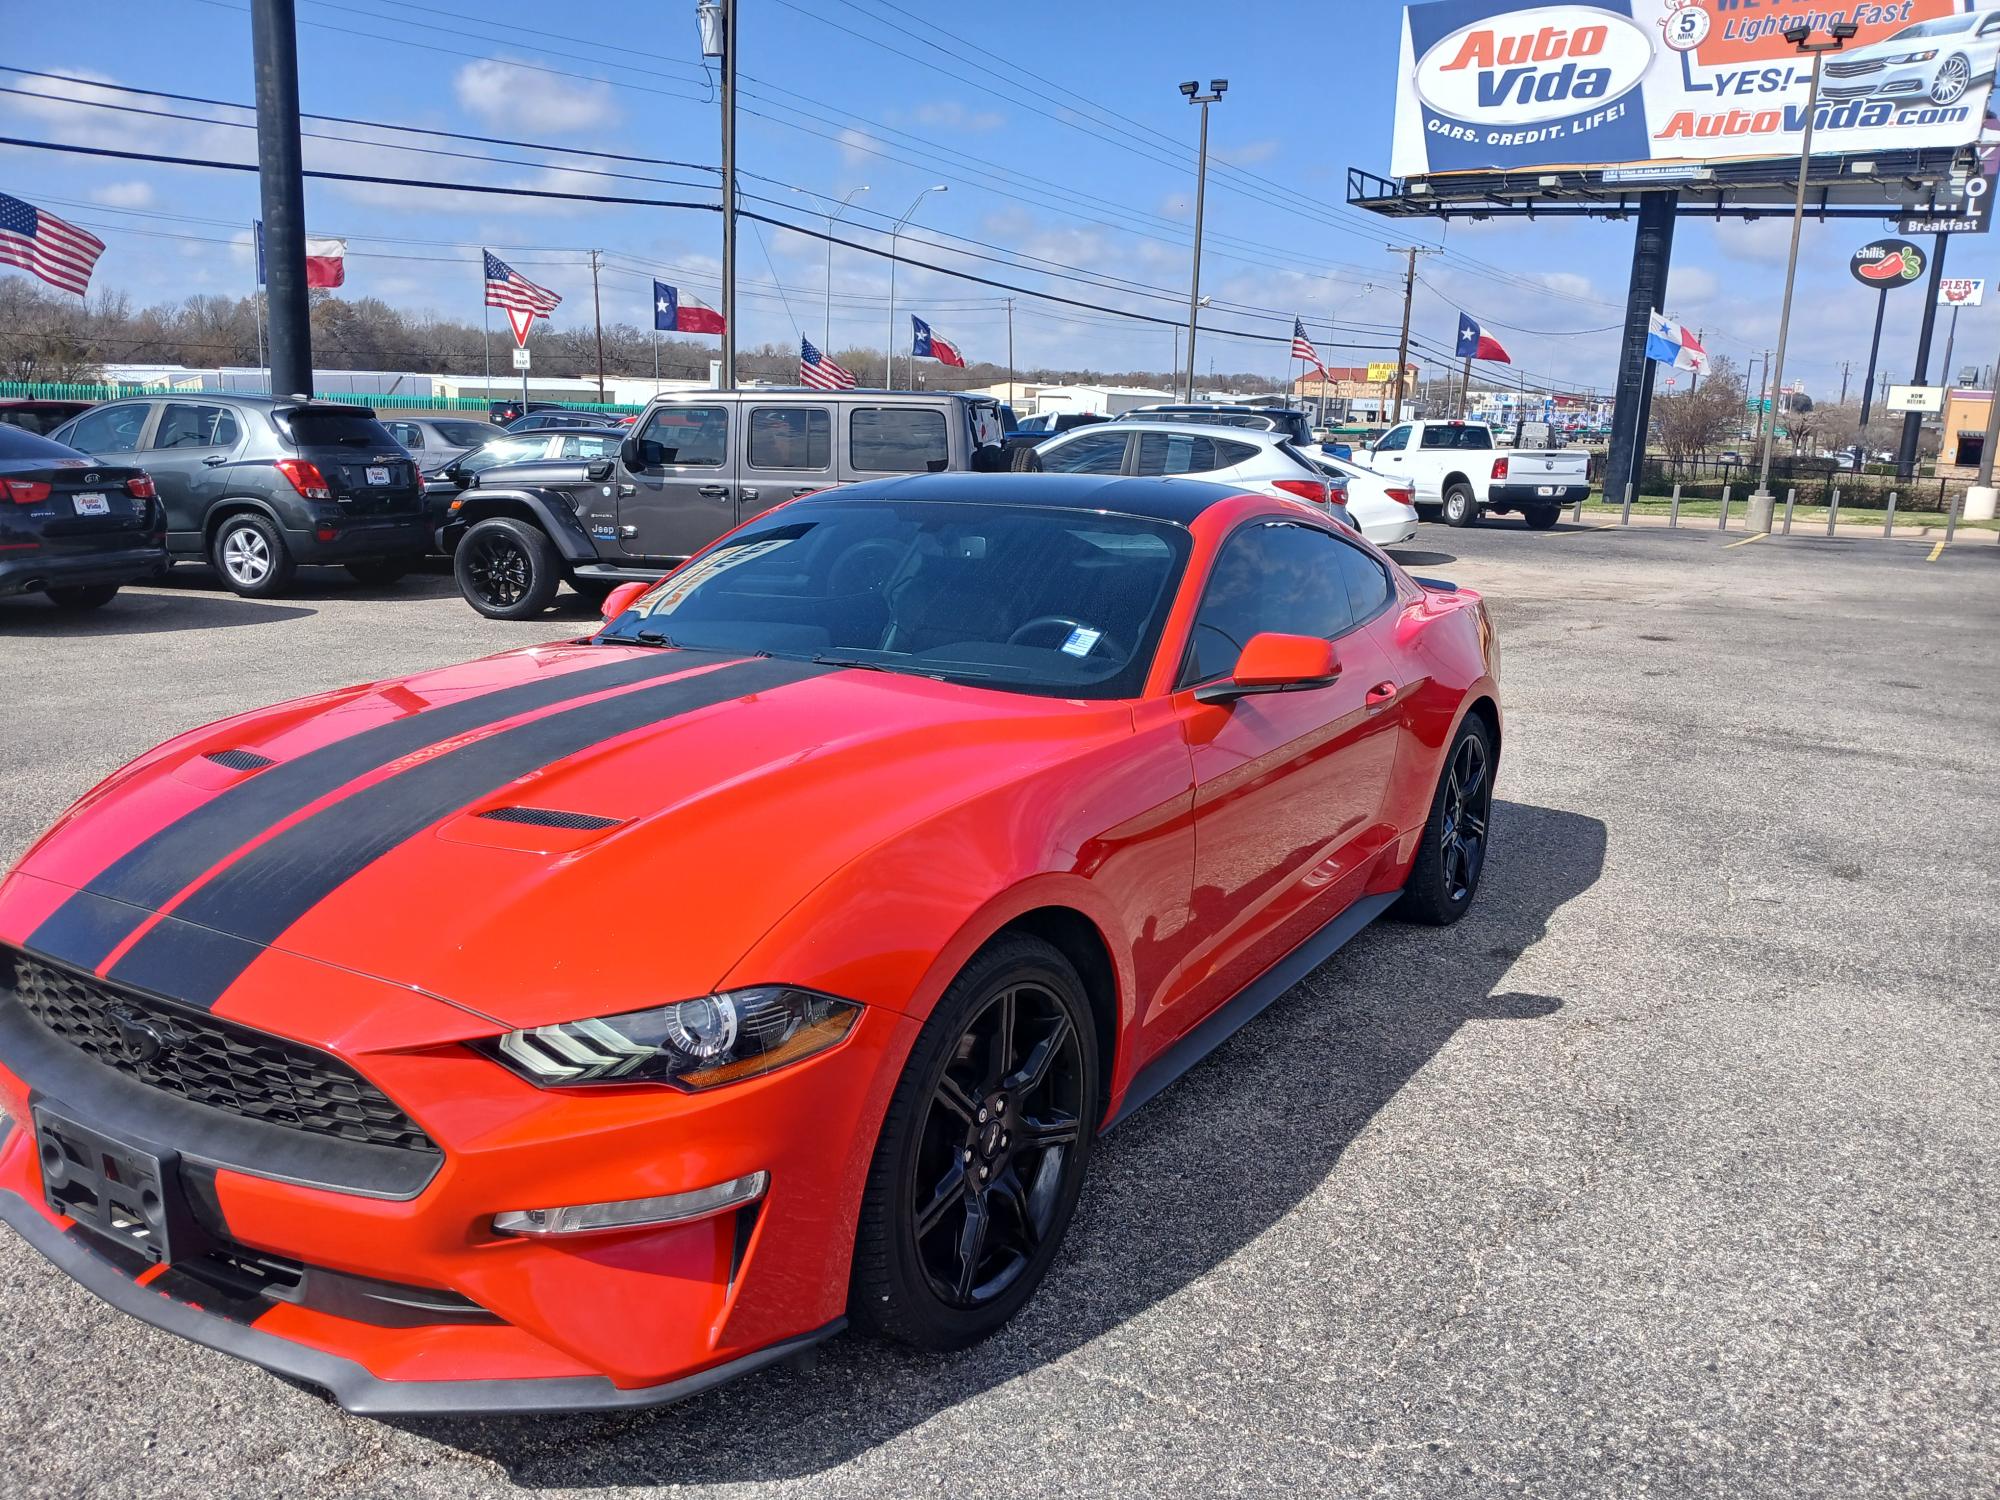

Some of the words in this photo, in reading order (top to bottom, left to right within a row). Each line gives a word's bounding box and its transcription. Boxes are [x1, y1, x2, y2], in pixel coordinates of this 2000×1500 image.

[1680, 14, 1696, 32] 5
[1722, 10, 1847, 42] Lightning
[1853, 1, 1914, 25] Fast
[1439, 25, 1608, 71] Auto
[1478, 63, 1612, 107] Vida
[1713, 67, 1794, 97] YES!
[1427, 119, 1480, 143] CARS.
[1486, 126, 1565, 146] CREDIT.
[1572, 103, 1626, 134] LIFE!
[1654, 100, 1969, 139] AutoVida.com
[1908, 218, 1978, 232] Breakfast
[1940, 280, 1971, 290] PIER
[1972, 281, 1981, 290] 7
[591, 524, 615, 535] Jeep
